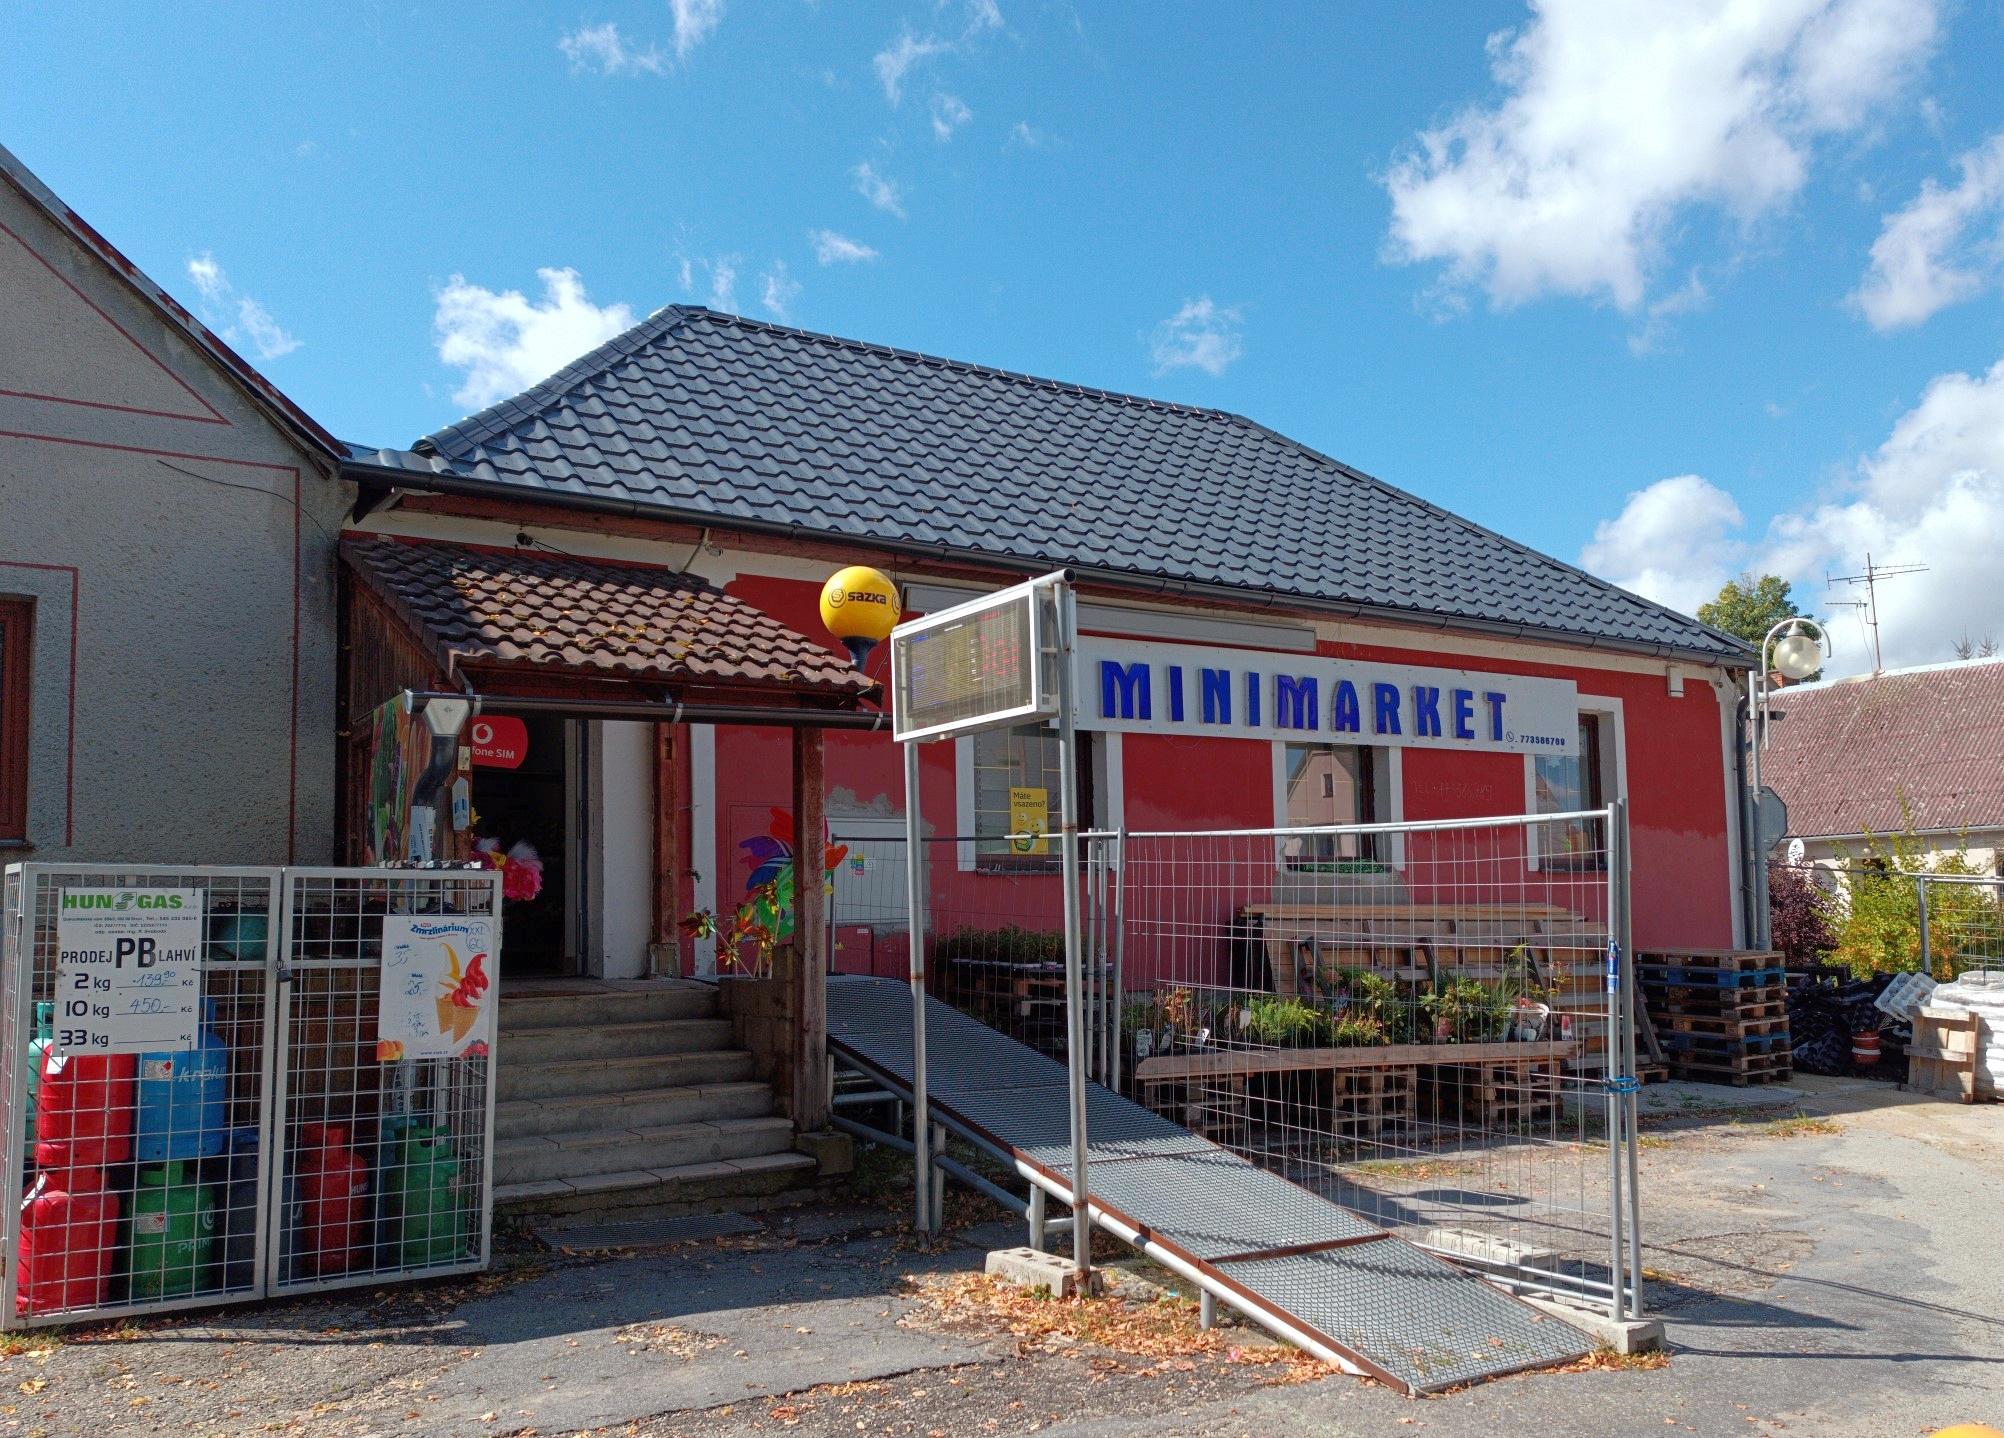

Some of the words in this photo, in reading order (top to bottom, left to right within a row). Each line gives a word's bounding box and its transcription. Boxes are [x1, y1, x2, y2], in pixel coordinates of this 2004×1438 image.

[847, 591, 887, 605] sazka
[1099, 660, 1507, 742] MINIMARKET
[495, 748, 515, 759] SIM
[1013, 791, 1031, 800] Máte
[1013, 800, 1047, 808] vsazeno?
[410, 922, 469, 936] Zmrzlinárium
[61, 950, 113, 964] PRODEJ
[115, 937, 157, 969] PB
[158, 946, 196, 962] LAHVÍ
[74, 972, 90, 990] 2
[93, 976, 111, 992] kg
[182, 979, 194, 987] Kč
[65, 1000, 89, 1017] 10
[93, 1003, 110, 1019] kg
[181, 1005, 193, 1013] Kč
[59, 1029, 88, 1046] 33
[92, 1032, 109, 1048] kg
[180, 1033, 192, 1041] Kč
